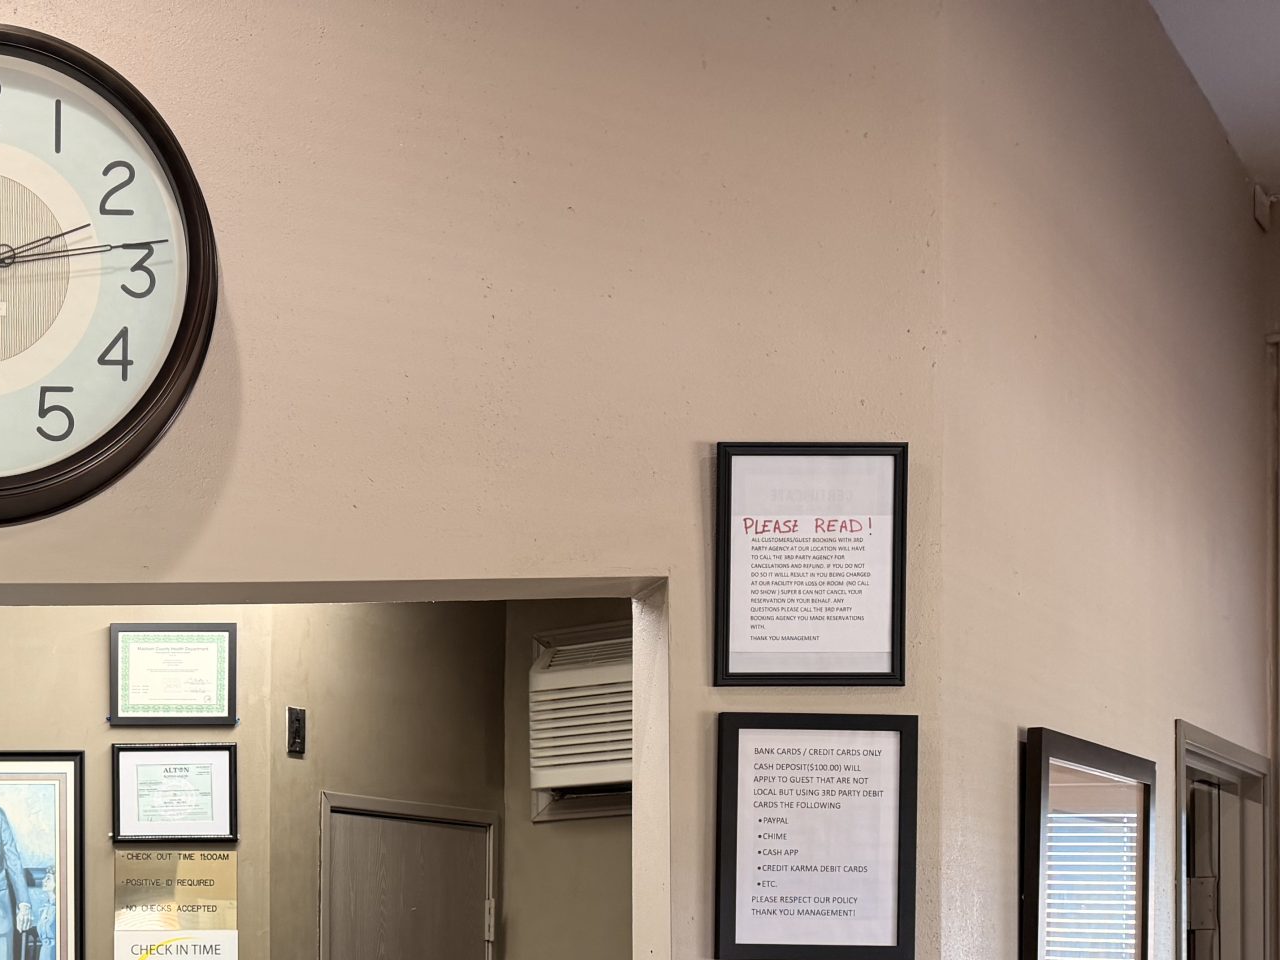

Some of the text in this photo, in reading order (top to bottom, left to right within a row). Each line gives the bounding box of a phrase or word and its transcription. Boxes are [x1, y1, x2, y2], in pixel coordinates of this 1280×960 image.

[55, 99, 62, 154] 1
[99, 161, 136, 216] 2
[120, 243, 156, 299] 3
[97, 326, 134, 382] 4
[36, 386, 75, 442] 5
[743, 518, 799, 535] PLEASE
[131, 944, 221, 956] CHECK IN TIME
